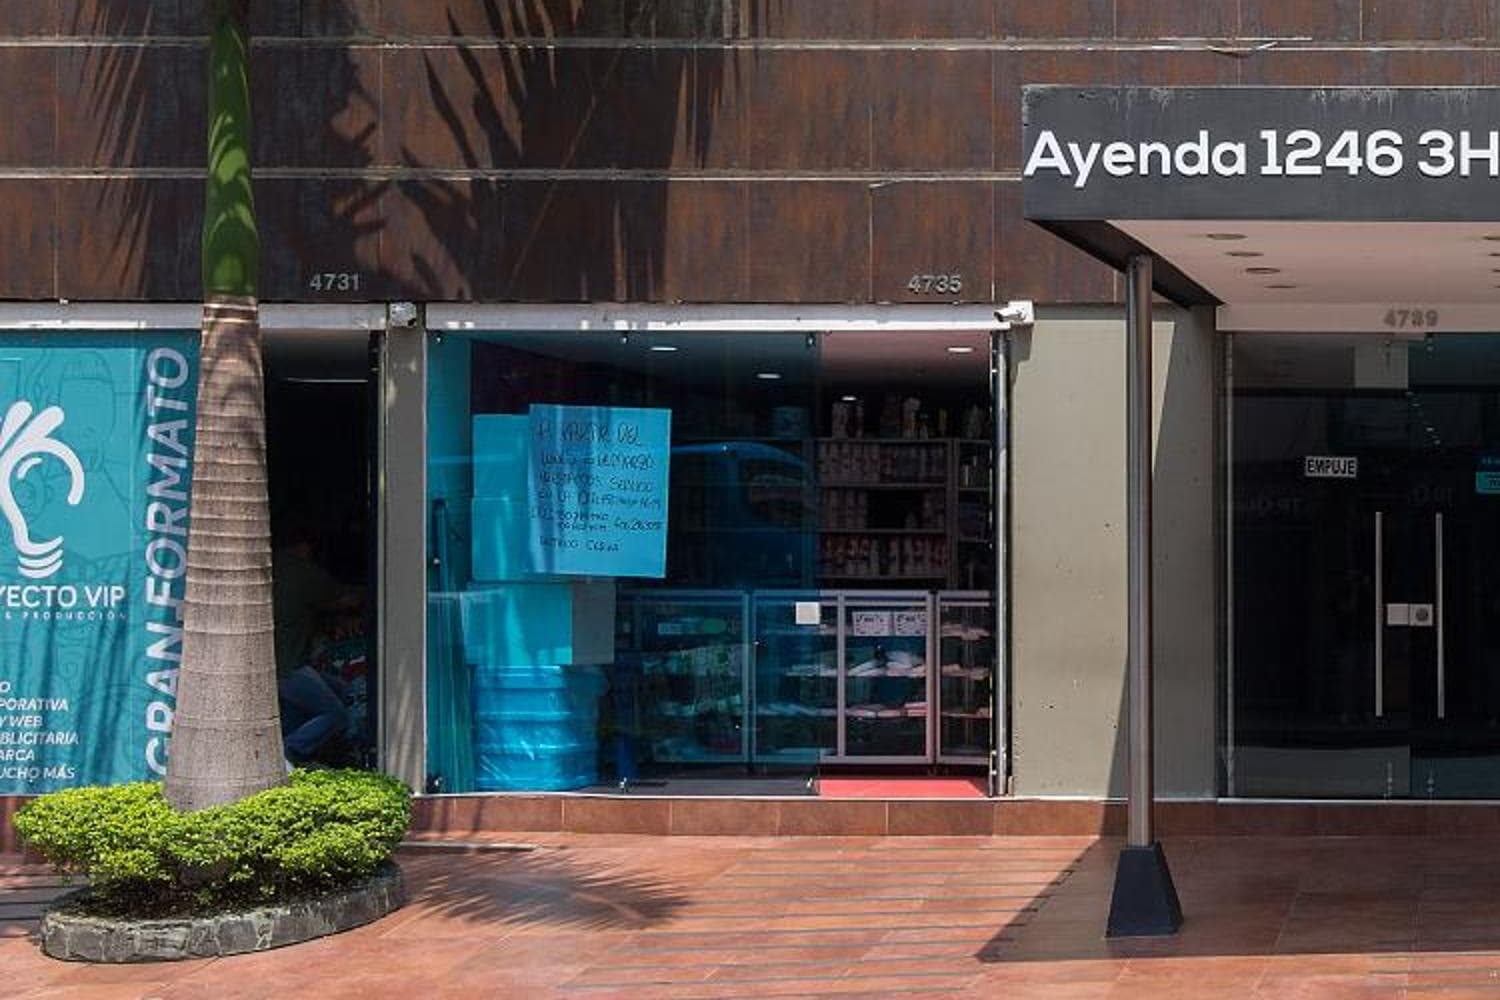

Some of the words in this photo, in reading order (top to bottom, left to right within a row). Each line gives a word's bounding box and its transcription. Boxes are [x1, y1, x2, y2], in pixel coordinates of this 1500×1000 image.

[1024, 130, 1247, 188] Ayenda
[1260, 129, 1404, 176] 1246
[1417, 129, 1499, 177] 3H
[309, 273, 359, 291] 4731
[908, 275, 962, 293] 4735
[1307, 459, 1356, 474] EMPUJE
[146, 347, 189, 606] FORMATO
[84, 585, 125, 607] VIP
[9, 715, 43, 728] WEB
